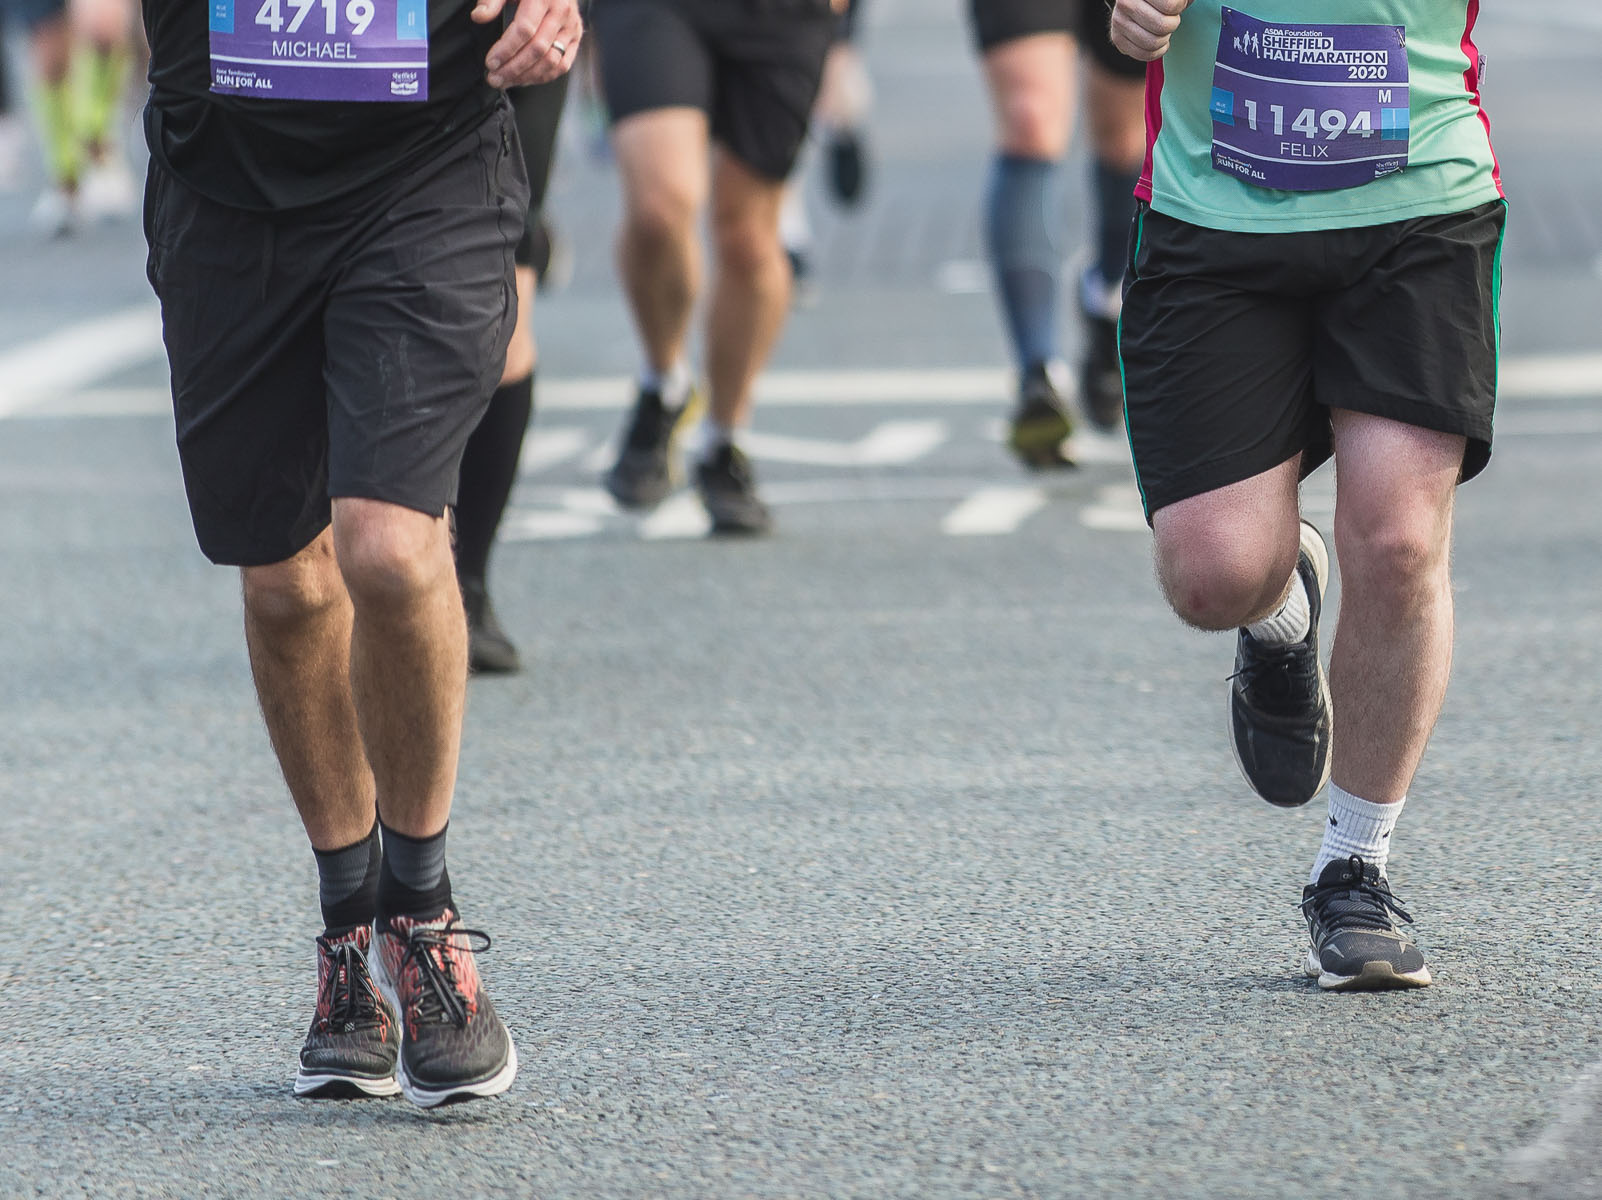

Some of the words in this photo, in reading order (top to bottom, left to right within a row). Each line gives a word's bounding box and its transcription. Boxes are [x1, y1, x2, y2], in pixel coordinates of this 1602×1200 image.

[1264, 28, 1284, 36] ASDA
[1285, 29, 1322, 37] Foundation
[272, 40, 357, 59] MICHAEL
[1264, 36, 1332, 50] SHEFFIELD
[1264, 50, 1299, 62] HALF
[1302, 51, 1385, 64] MARATHON
[1348, 66, 1387, 79] 2020
[216, 74, 234, 85] RUN
[255, 78, 273, 89] ALL
[1378, 89, 1392, 103] M
[1244, 99, 1375, 140] 11494
[1280, 142, 1329, 157] FELIX
[1217, 158, 1234, 169] RUN
[1235, 164, 1249, 175] FOR
[1251, 170, 1266, 180] ALL
